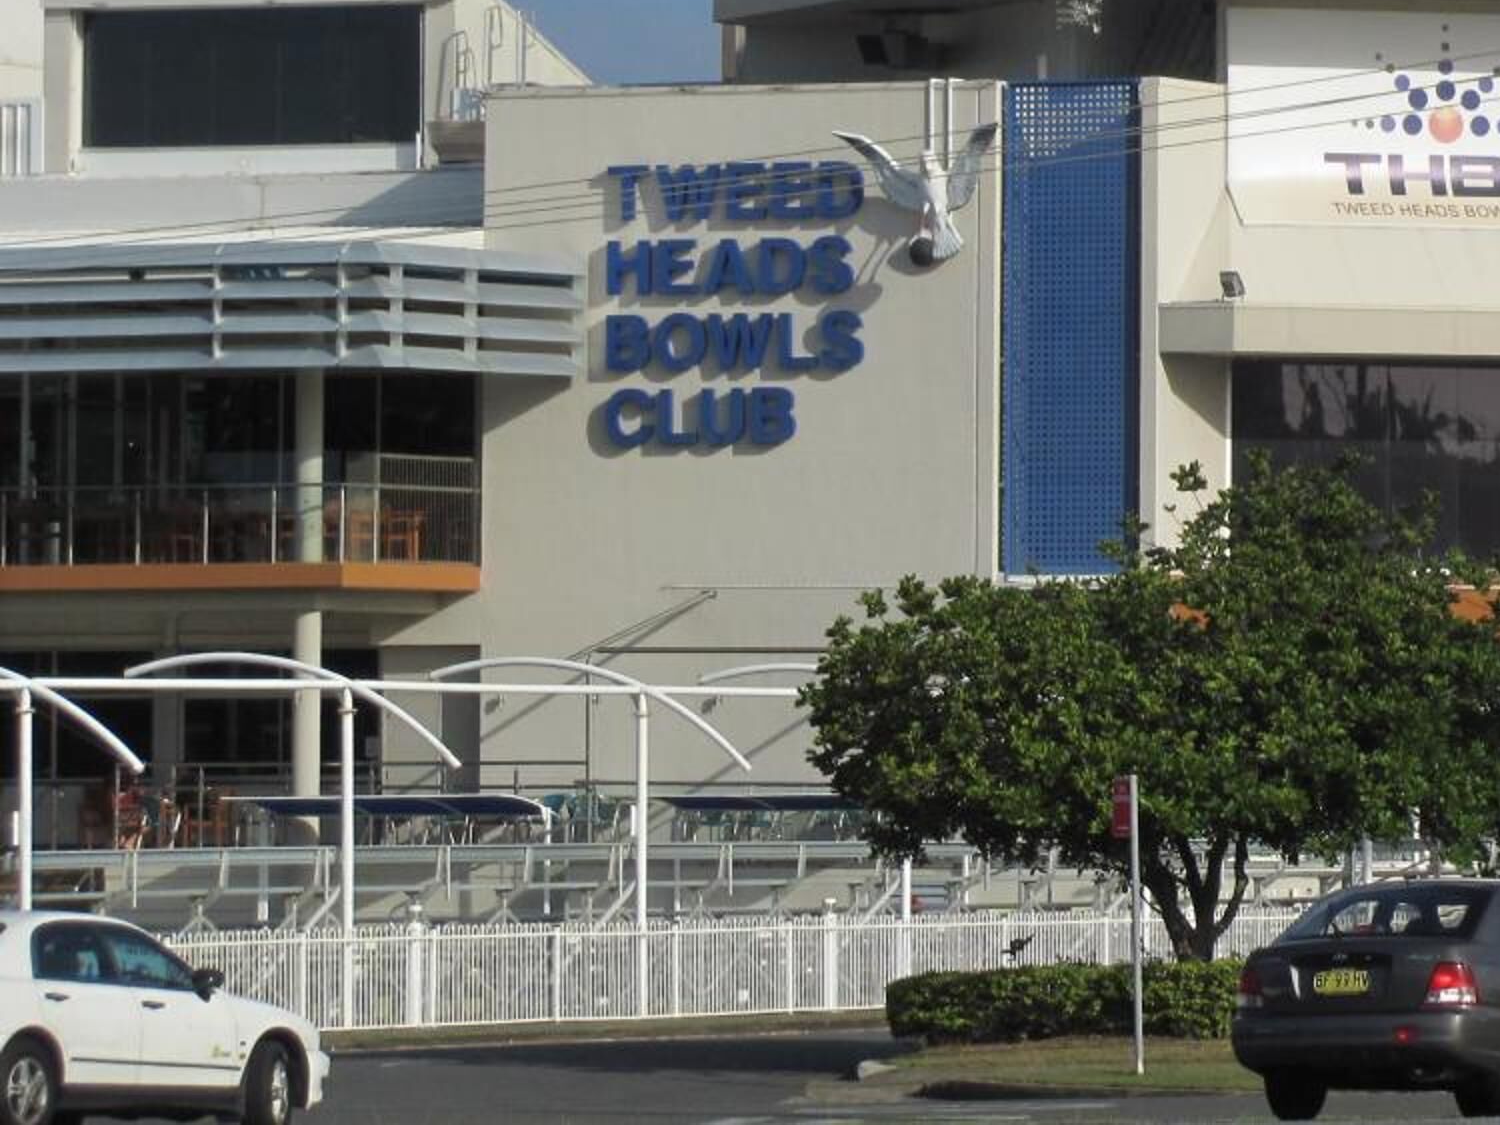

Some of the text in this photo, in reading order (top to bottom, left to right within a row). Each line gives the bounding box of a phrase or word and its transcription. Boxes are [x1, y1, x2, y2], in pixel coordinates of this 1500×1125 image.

[607, 161, 864, 221] TWEED
[1332, 202, 1394, 216] TWEED
[1400, 204, 1459, 218] HEADS
[606, 235, 855, 296] HEADS
[606, 310, 864, 372] BOWLS
[606, 387, 796, 449] CLUB
